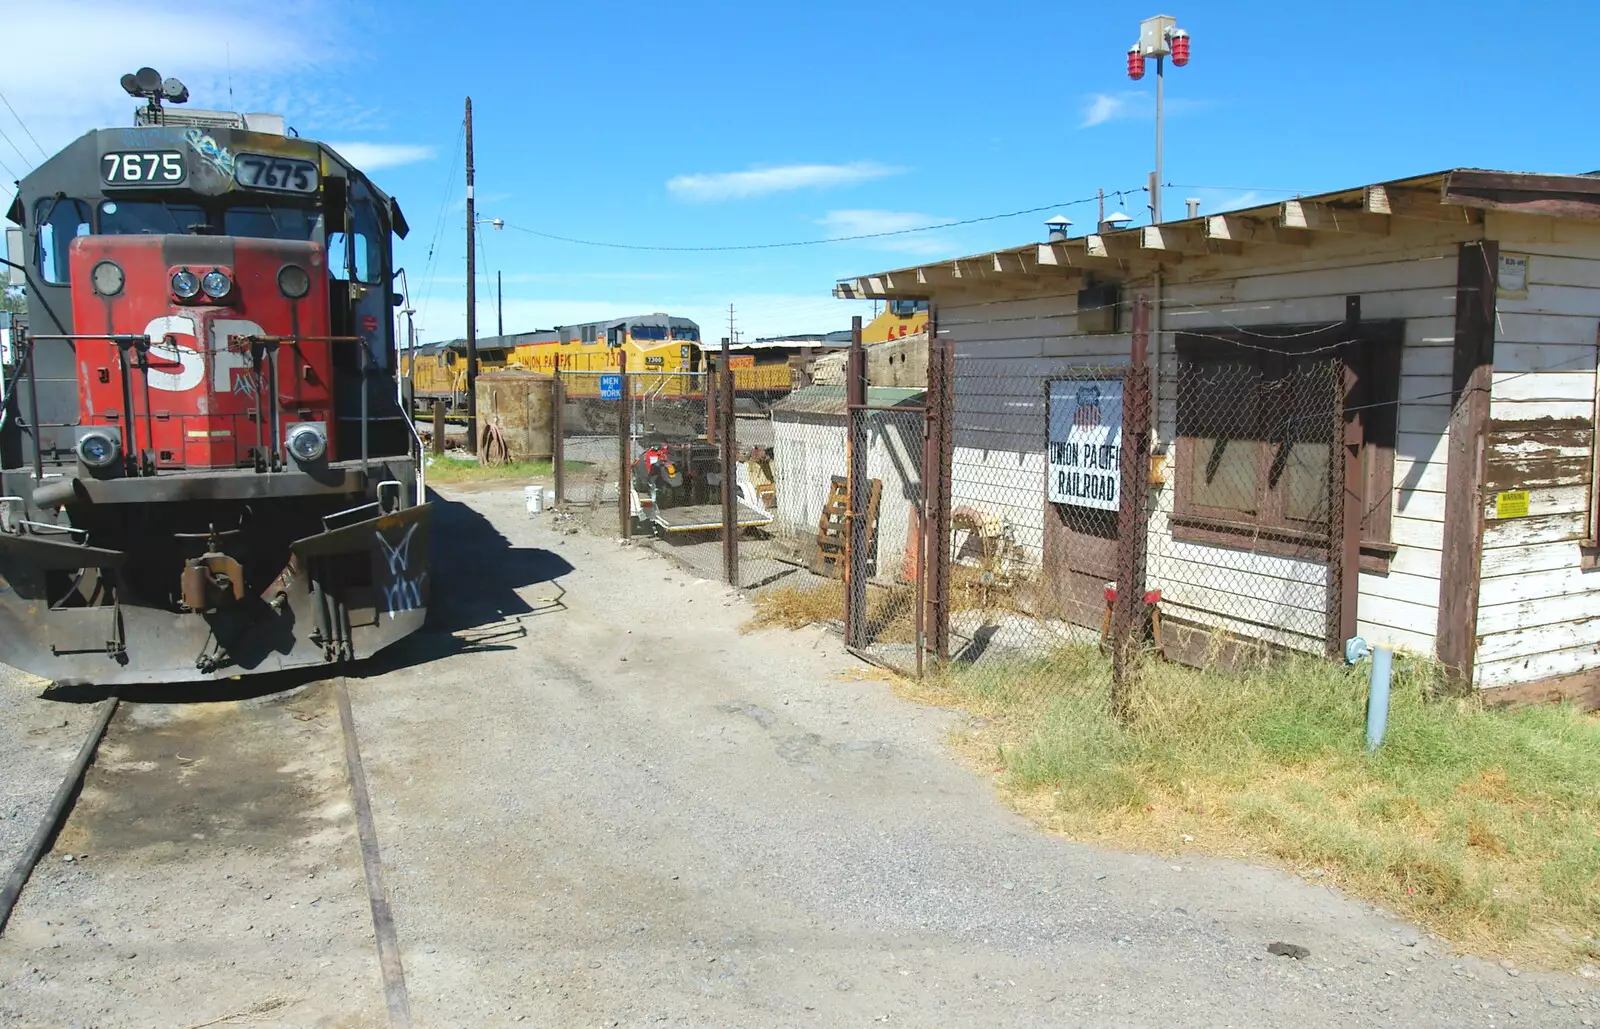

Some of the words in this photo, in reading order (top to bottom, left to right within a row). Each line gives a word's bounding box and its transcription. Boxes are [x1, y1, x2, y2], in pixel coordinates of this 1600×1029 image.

[104, 154, 182, 181] 7675
[244, 160, 314, 190] 7675
[602, 377, 619, 385] MEN
[1050, 441, 1078, 467] UNION
[1084, 443, 1122, 471] PACIFI
[1058, 470, 1115, 501] RAILROAD
[1502, 492, 1525, 501] WARNING
